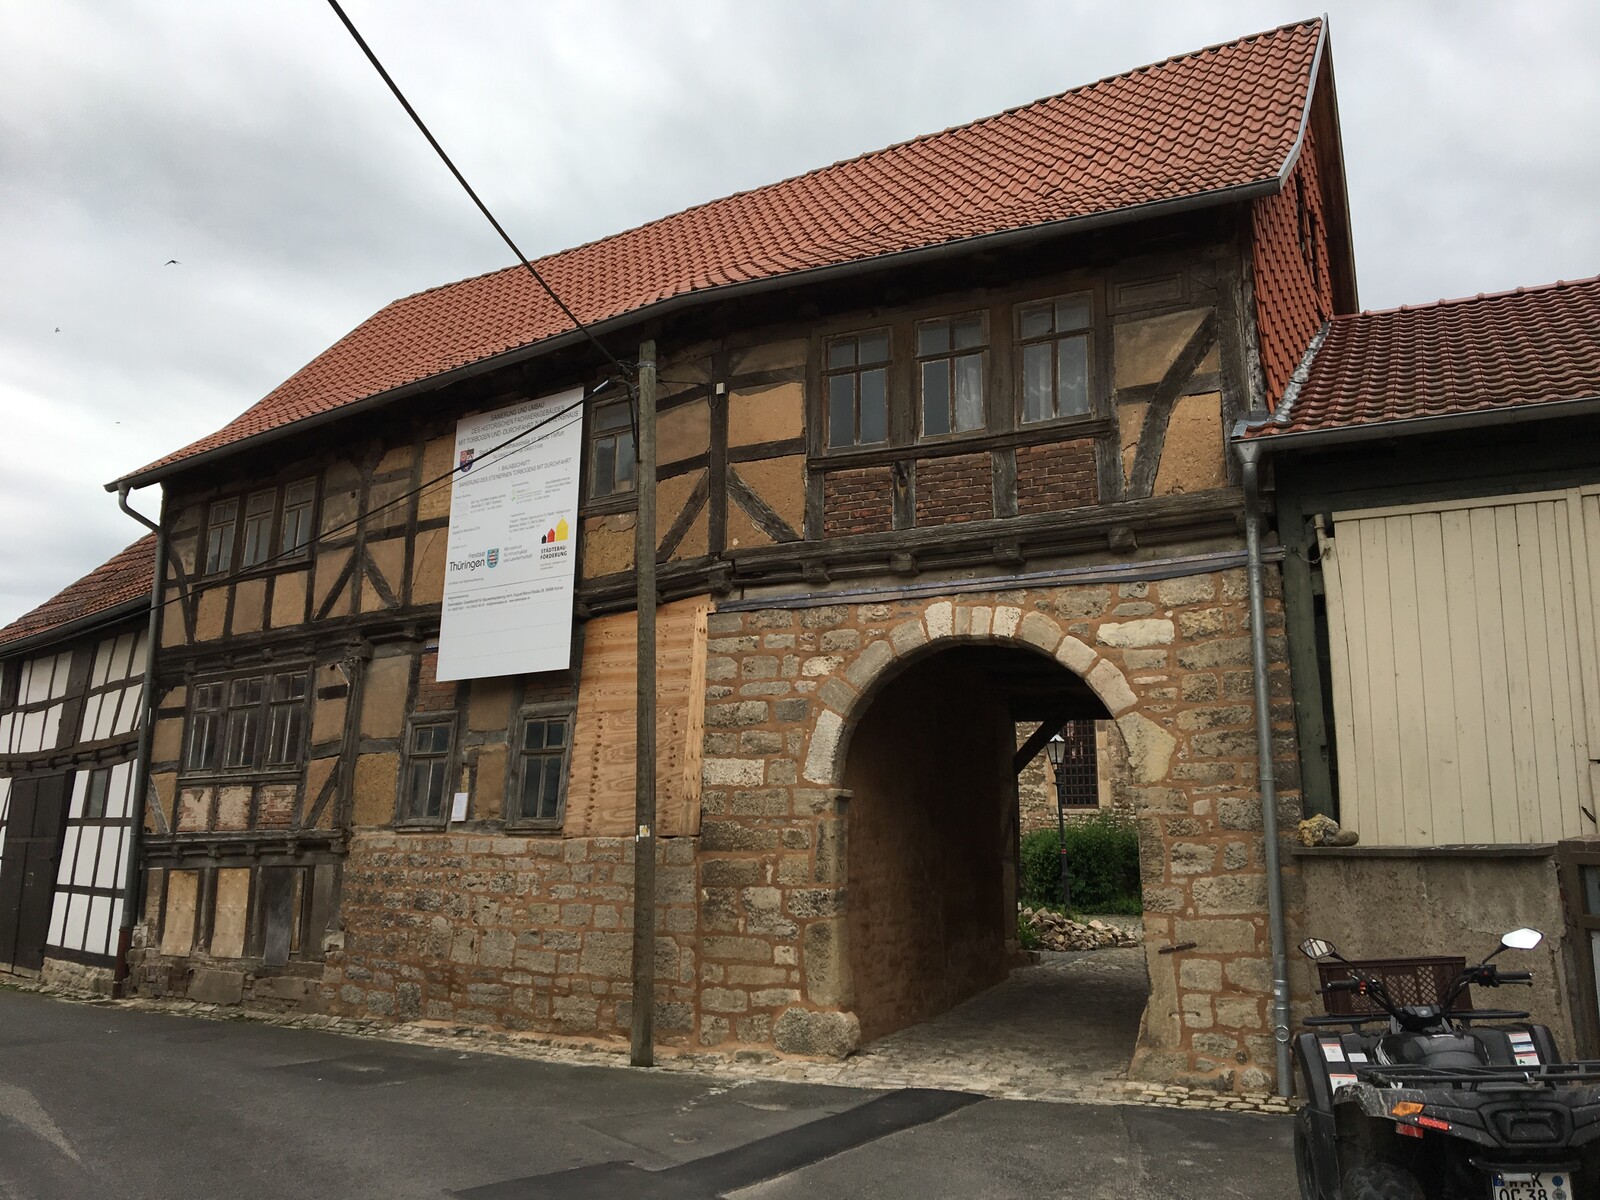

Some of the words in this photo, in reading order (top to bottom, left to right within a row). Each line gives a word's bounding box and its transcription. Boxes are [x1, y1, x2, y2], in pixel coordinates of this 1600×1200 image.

[491, 409, 517, 421] SANIERUNG
[518, 406, 527, 415] UND
[528, 402, 544, 411] UMBAU
[472, 426, 480, 434] DES
[481, 417, 513, 433] HISTORISCHEN
[540, 551, 567, 560] FÖRDERUNG
[449, 557, 485, 572] Thüringen
